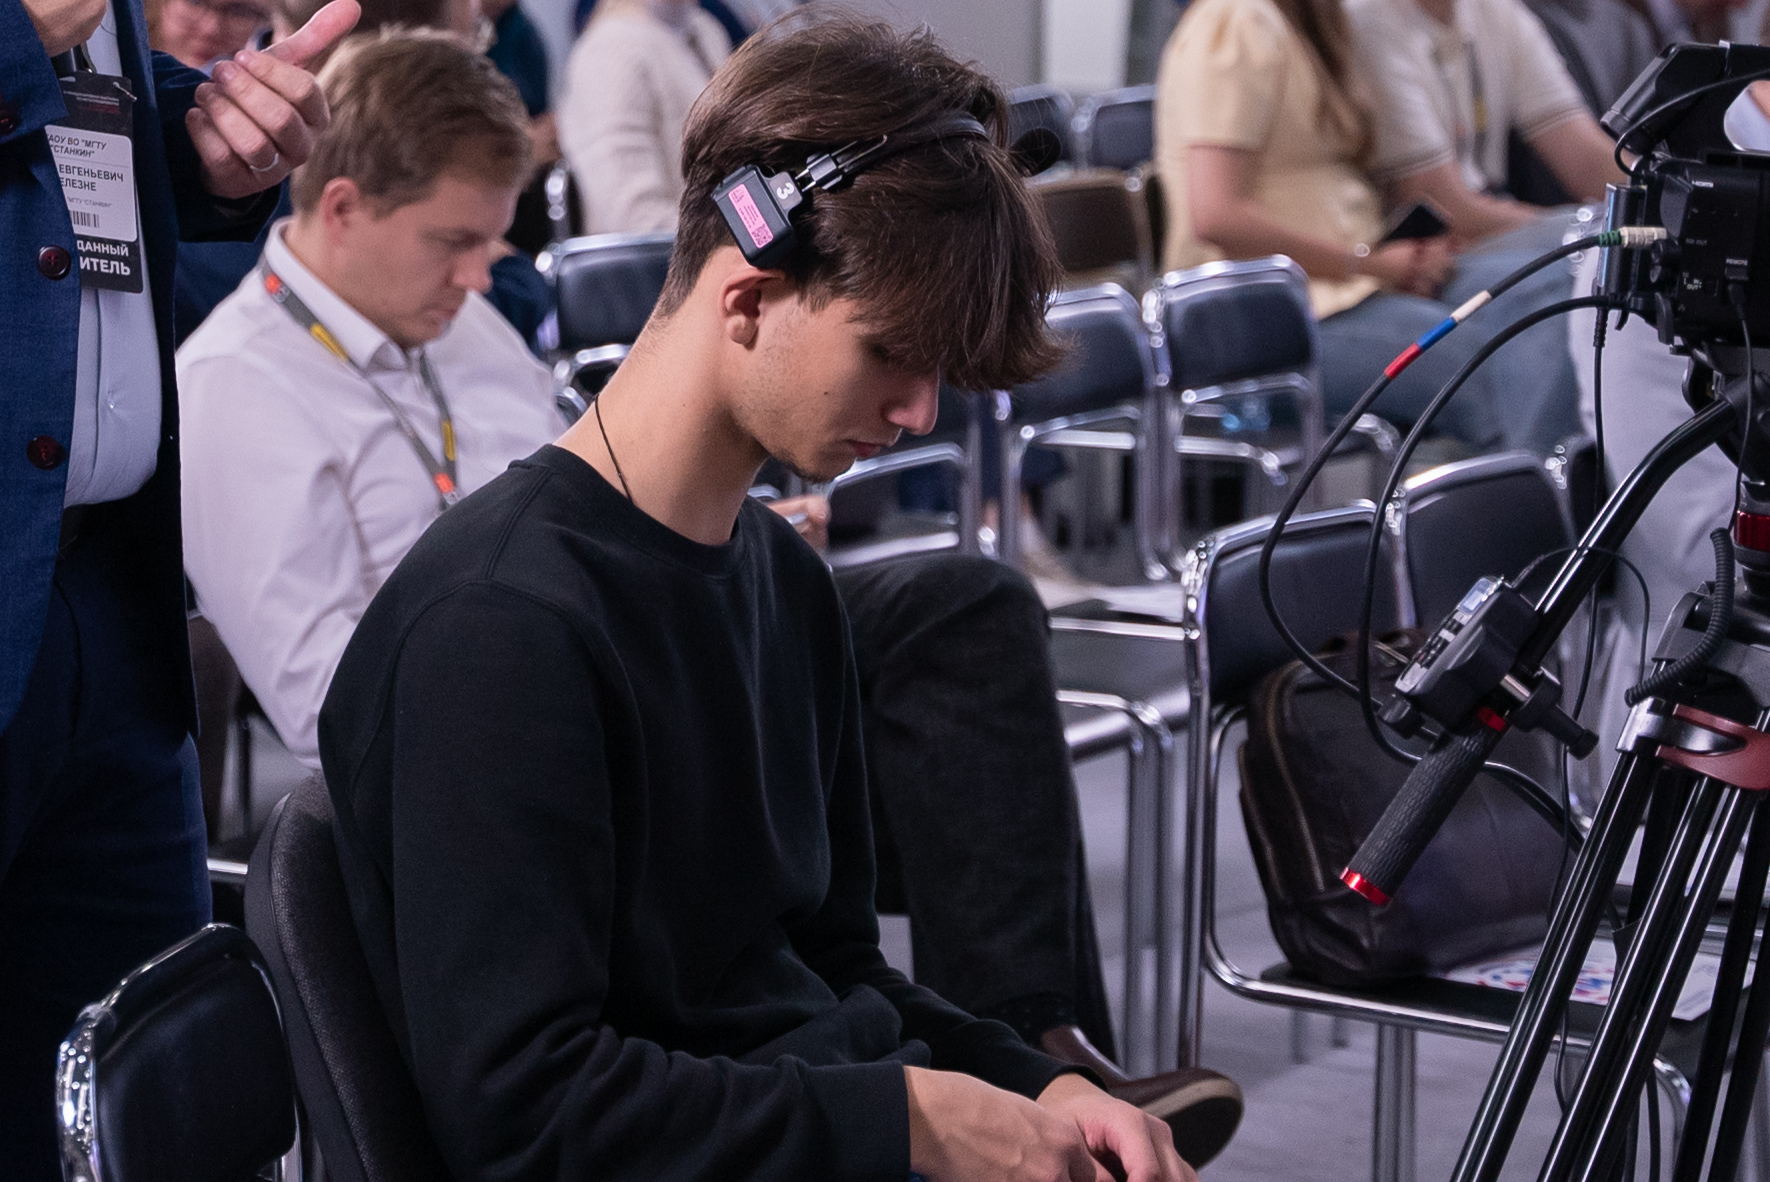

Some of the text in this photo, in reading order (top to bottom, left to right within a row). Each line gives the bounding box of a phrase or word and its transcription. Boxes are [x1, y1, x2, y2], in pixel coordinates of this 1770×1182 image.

[68, 137, 80, 146] ВО
[59, 163, 124, 182] ЕВГЕНЬЕВИЧ
[777, 182, 795, 199] 3
[80, 255, 131, 276] ИТЕЛЬ
